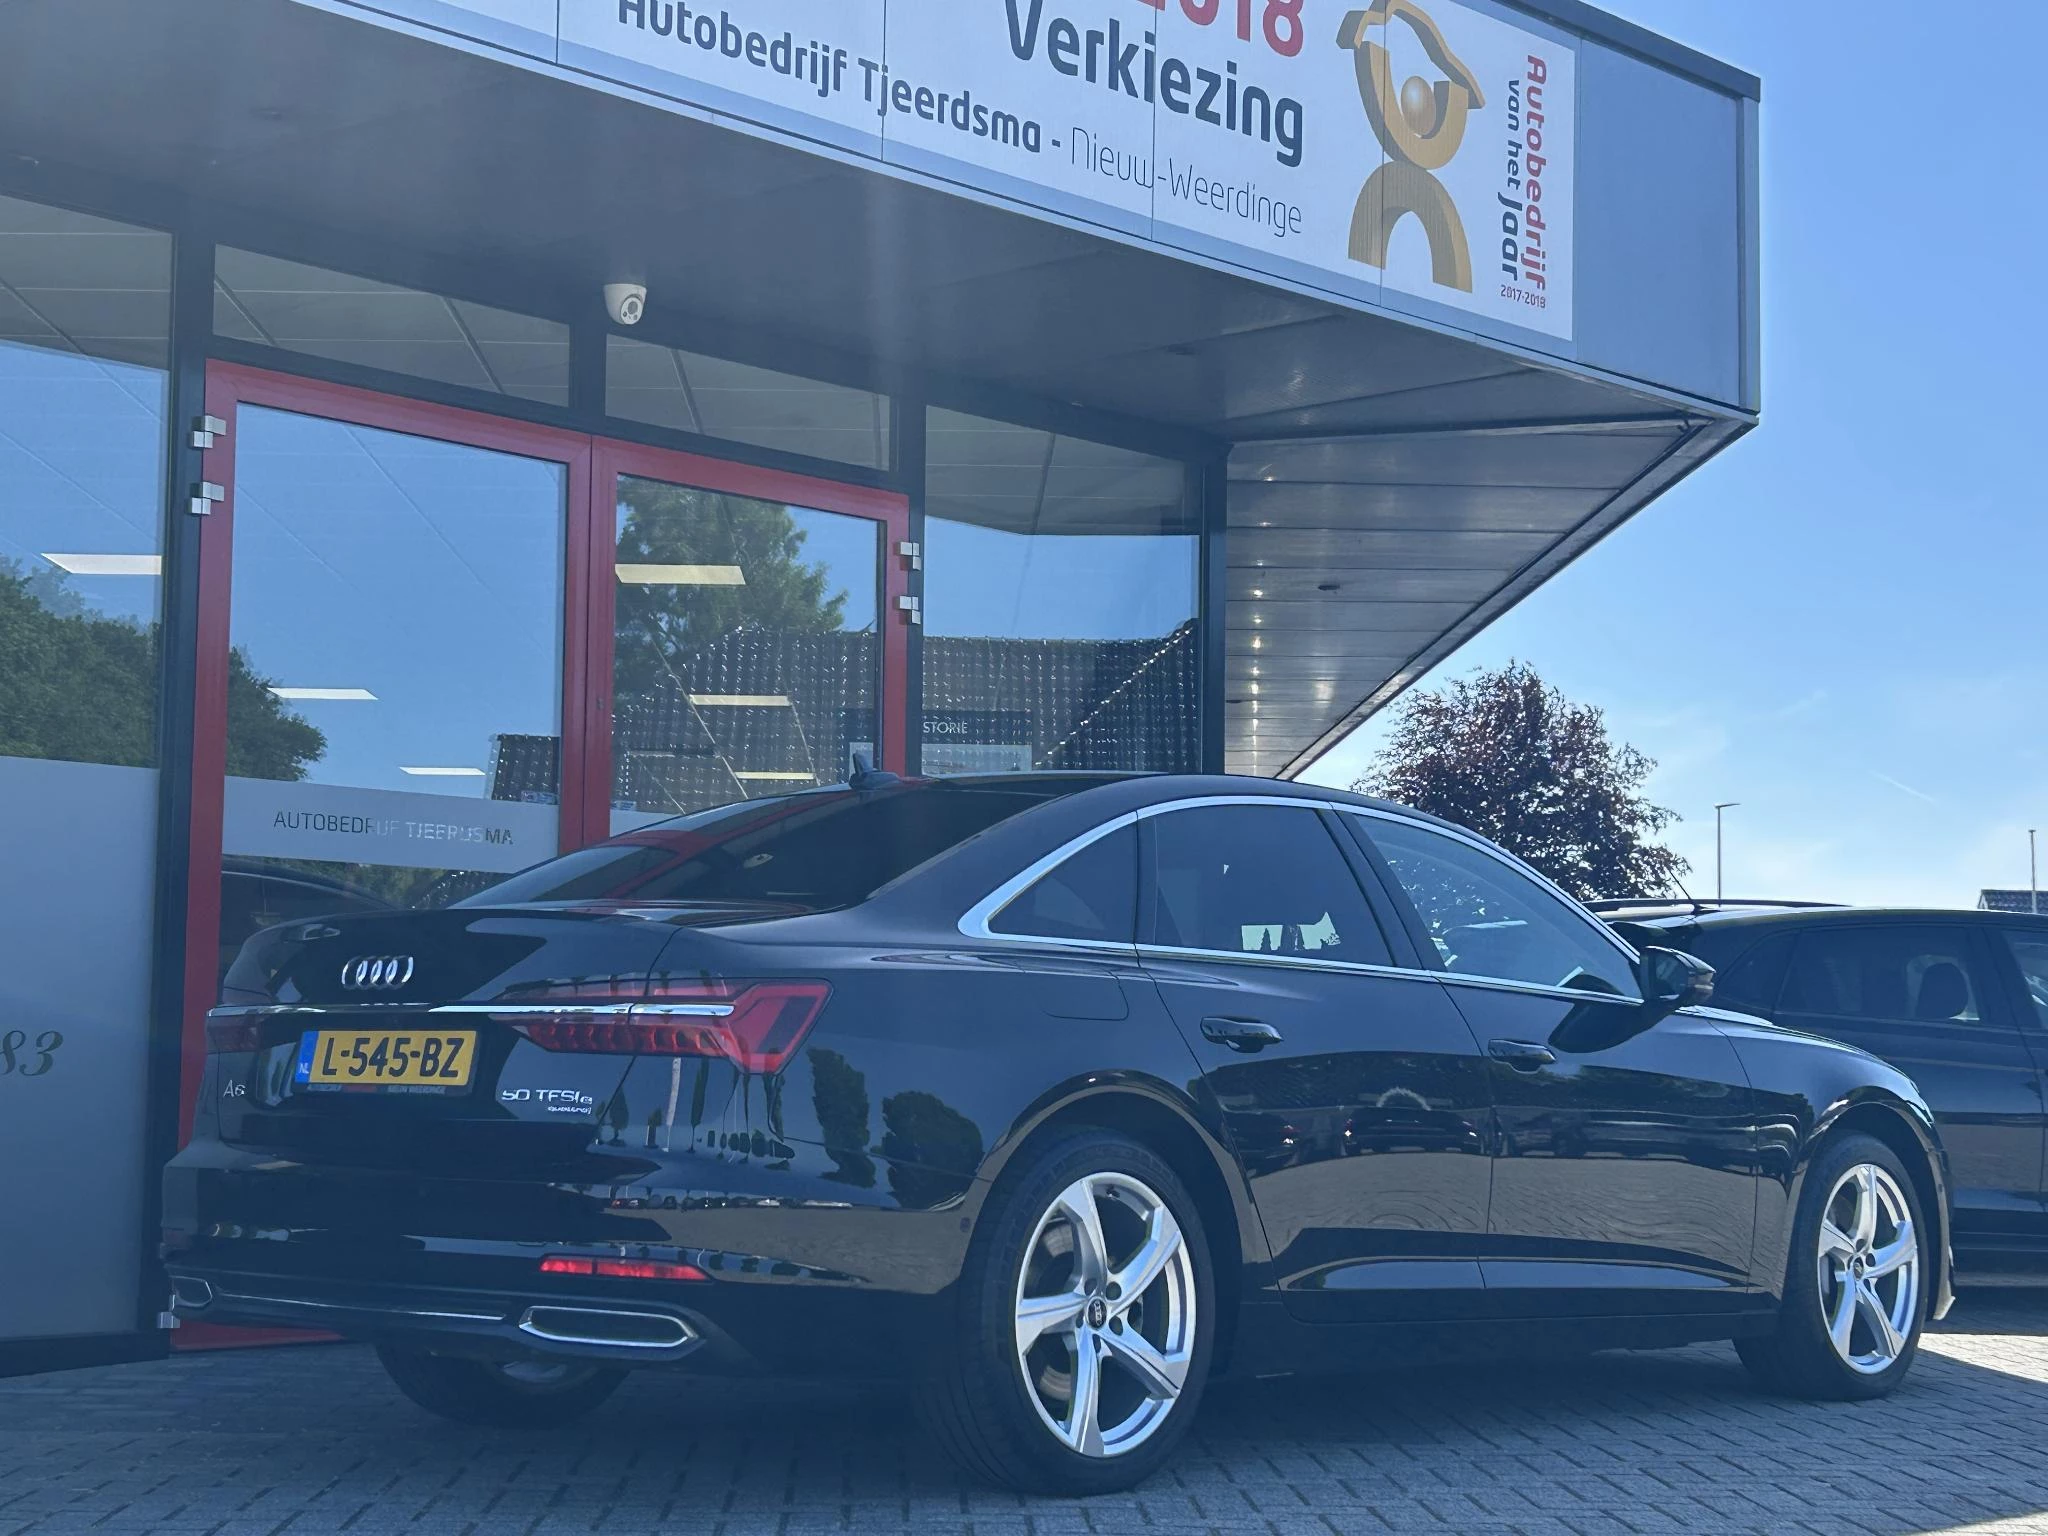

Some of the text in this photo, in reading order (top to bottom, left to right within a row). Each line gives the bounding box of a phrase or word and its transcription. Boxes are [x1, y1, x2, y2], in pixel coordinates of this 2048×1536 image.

[1136, 0, 1304, 57] 18
[1005, 0, 1303, 168] Verkiezing
[619, 0, 847, 98] Autobedrijf
[858, 57, 1041, 153] Tjeerdsma
[1071, 126, 1302, 238] Nieuw-Weerdinge
[1498, 79, 1523, 282] van het Jaar
[1521, 54, 1547, 291] Autobedrijf
[298, 1062, 310, 1075] NL
[322, 1037, 465, 1077] L-545-BZ
[223, 1079, 246, 1097] A6
[501, 1089, 531, 1101] 50
